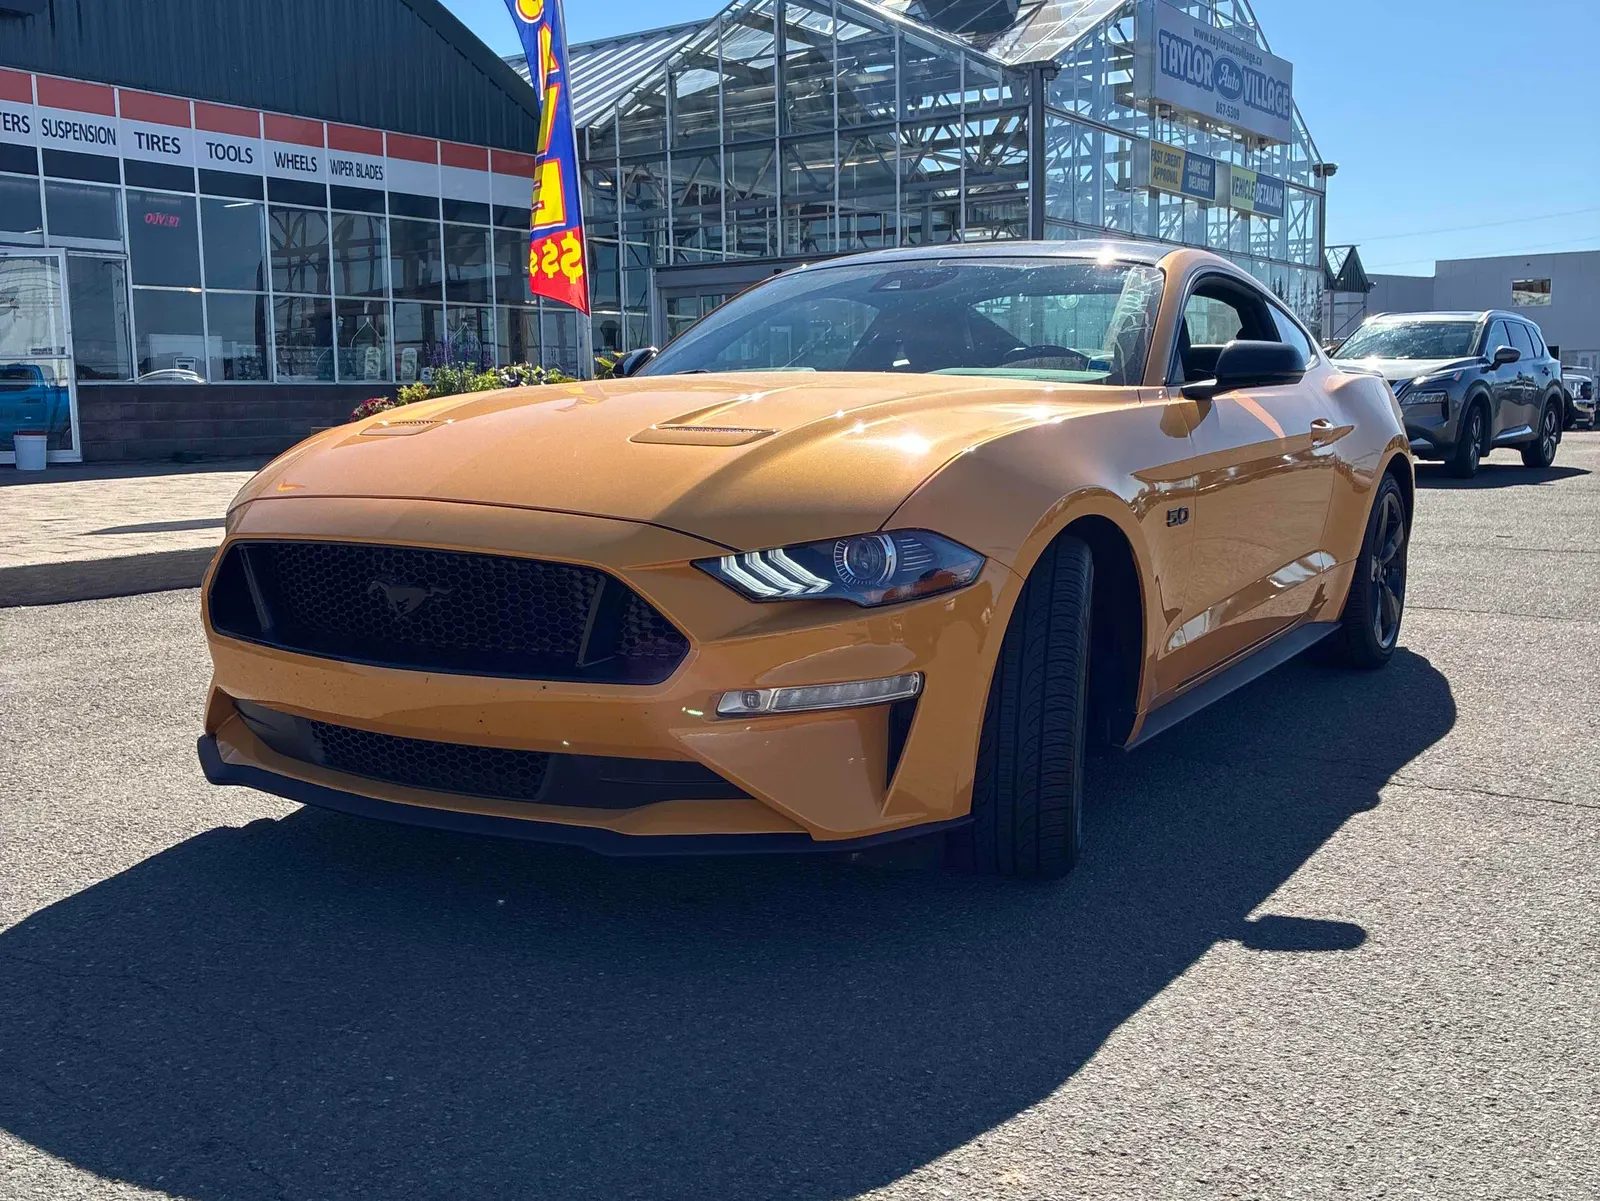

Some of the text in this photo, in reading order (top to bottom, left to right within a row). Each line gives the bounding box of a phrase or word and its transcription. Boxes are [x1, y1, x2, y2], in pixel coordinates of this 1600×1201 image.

[1159, 29, 1290, 121] TAYLOR Auto VILLAGE
[0, 111, 31, 134] ERS
[41, 118, 117, 146] SUSPENSION
[133, 131, 181, 155] TIRES
[206, 142, 253, 164] TOOLS
[273, 151, 317, 172] WHEELS
[329, 159, 384, 181] WIPER BLADES
[1231, 175, 1255, 201] VEHICLE
[1255, 182, 1283, 208] DETAILING
